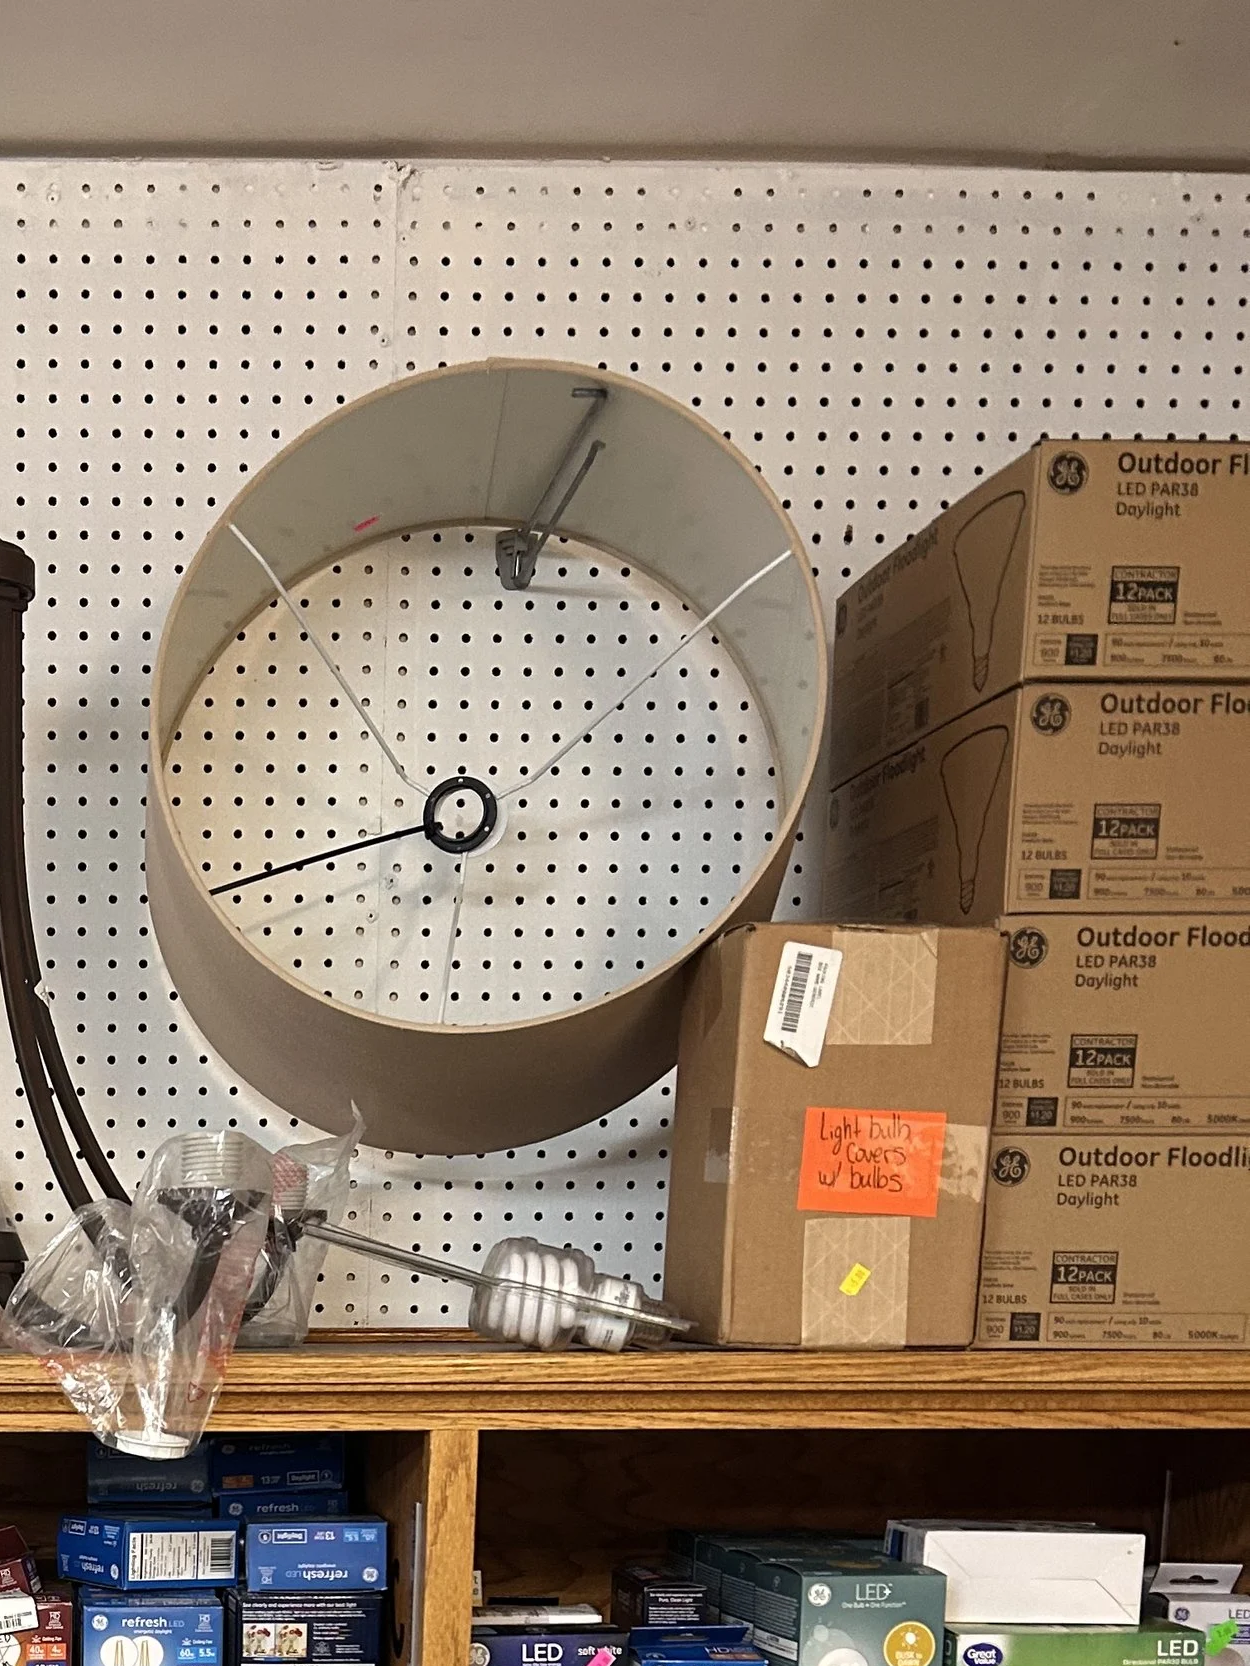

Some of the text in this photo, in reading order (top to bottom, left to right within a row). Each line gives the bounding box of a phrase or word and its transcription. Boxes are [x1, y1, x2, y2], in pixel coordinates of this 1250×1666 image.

[1117, 451, 1222, 477] Outdoor
[1117, 482, 1198, 497] LED PAR38
[1116, 502, 1180, 518] Daylight
[1100, 693, 1202, 715] Outdoor
[1100, 721, 1179, 736] LED PAR38
[1098, 742, 1162, 757] Daylight
[1077, 926, 1180, 948] Outdoor
[1076, 955, 1157, 968] LED PAR38
[1075, 974, 1138, 990] Daylight
[819, 1113, 911, 1157] Light bulb
[1059, 1146, 1161, 1168] Outdoor
[850, 1166, 903, 1192] bulbs
[1058, 1173, 1138, 1188] LED PAR38
[1056, 1192, 1120, 1209] Daylight
[121, 1616, 184, 1628] refresh LED
[522, 1643, 562, 1662] LED
[967, 1649, 996, 1661] Great
[1157, 1640, 1198, 1656] LED
[974, 1657, 996, 1665] Value
